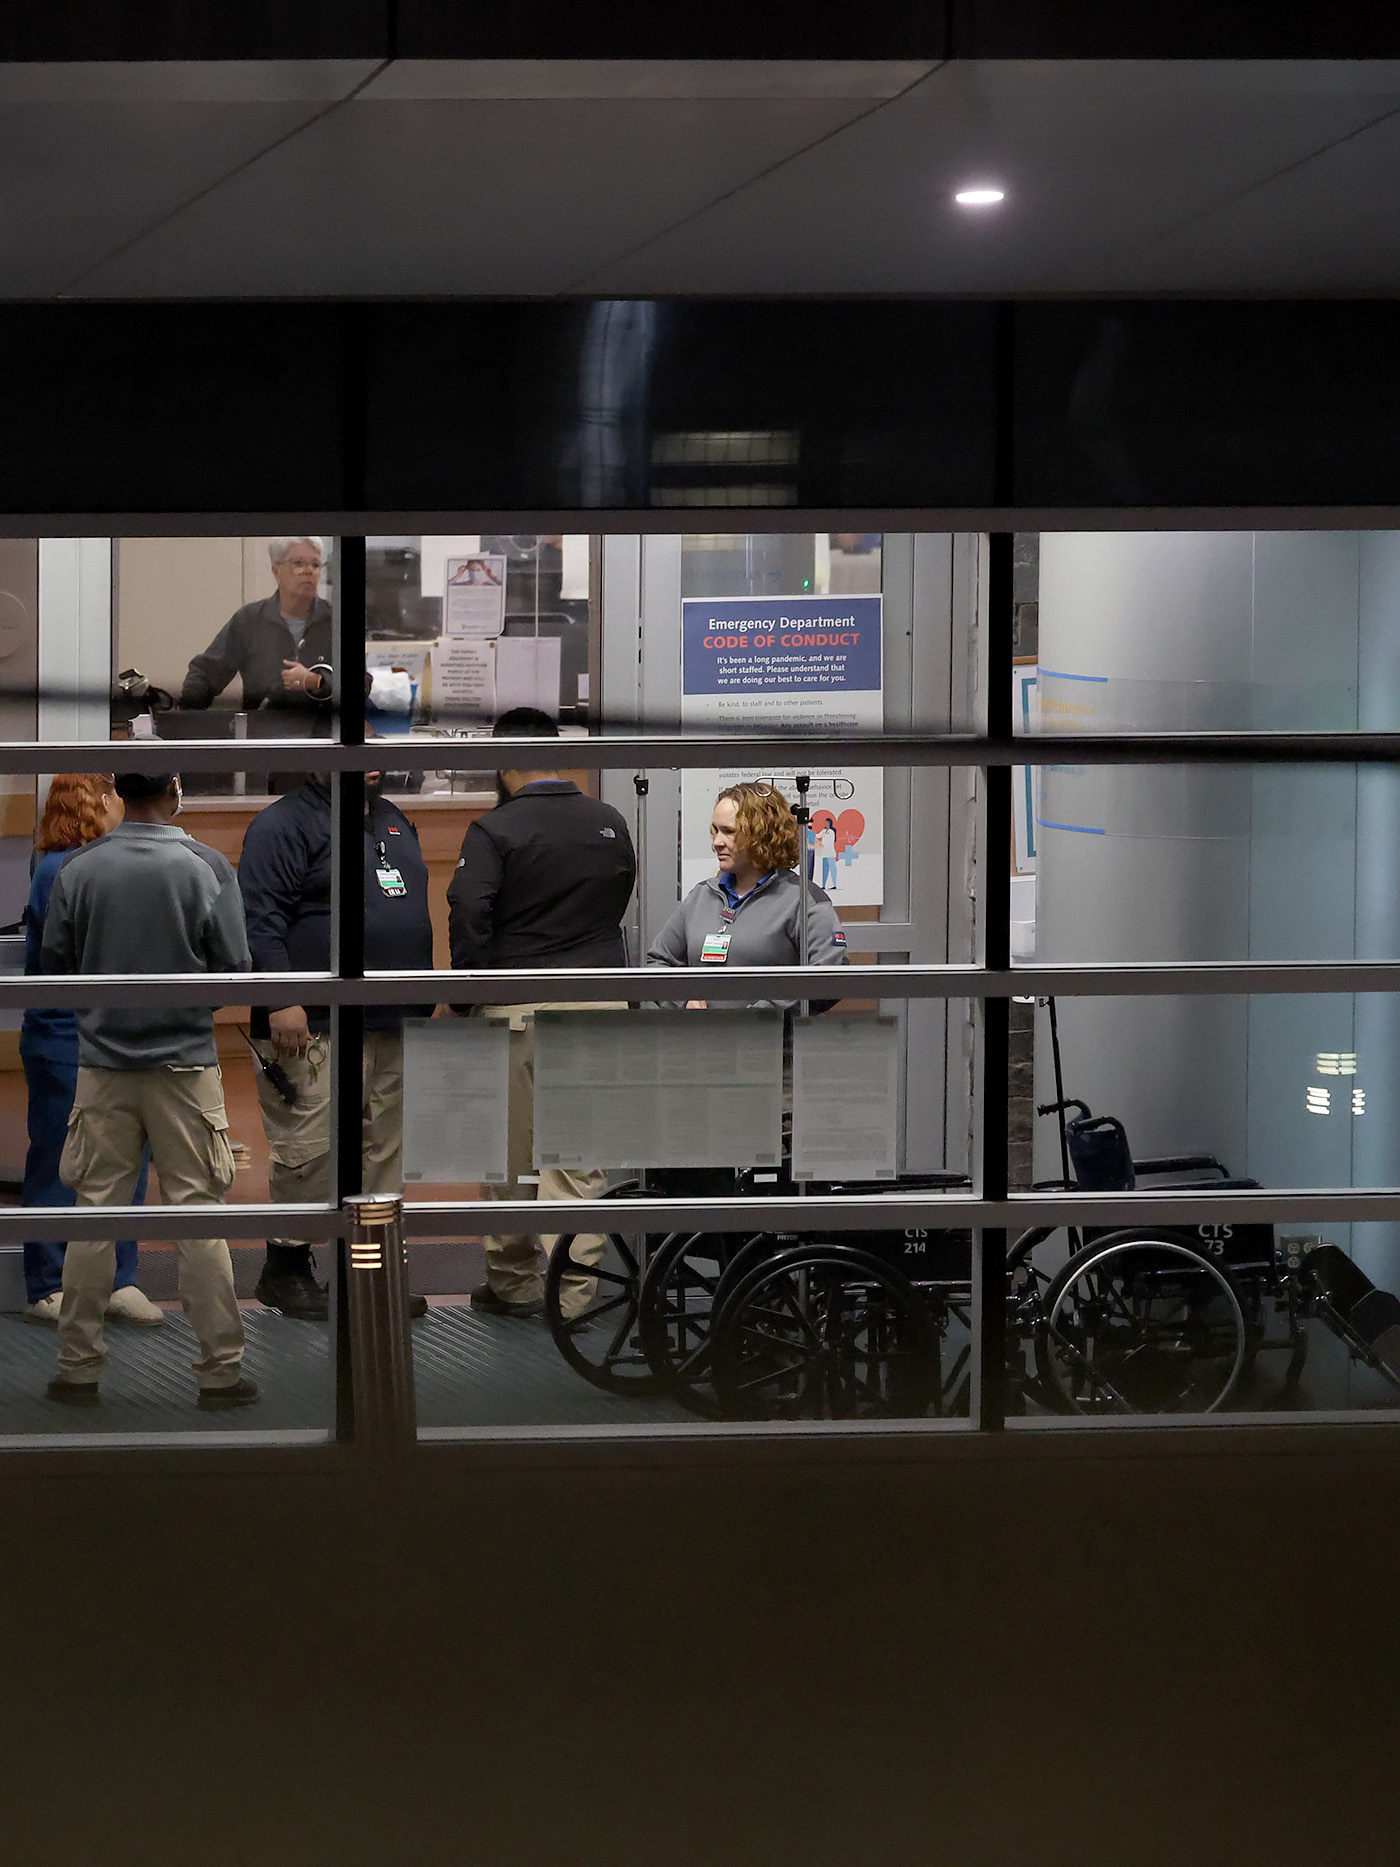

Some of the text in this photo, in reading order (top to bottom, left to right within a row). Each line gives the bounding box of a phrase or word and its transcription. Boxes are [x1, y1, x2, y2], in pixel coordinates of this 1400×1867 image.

[708, 616, 855, 632] Emergency Department
[703, 633, 860, 649] CODE OF CONDUCT
[729, 656, 747, 664] been
[754, 656, 770, 664] long
[771, 655, 807, 664] pandemic,
[809, 654, 822, 662] and
[739, 666, 765, 674] staffed.
[742, 676, 762, 685] doing
[777, 675, 793, 683] best
[1198, 1224, 1233, 1239] CTS
[904, 1242, 926, 1254] 214
